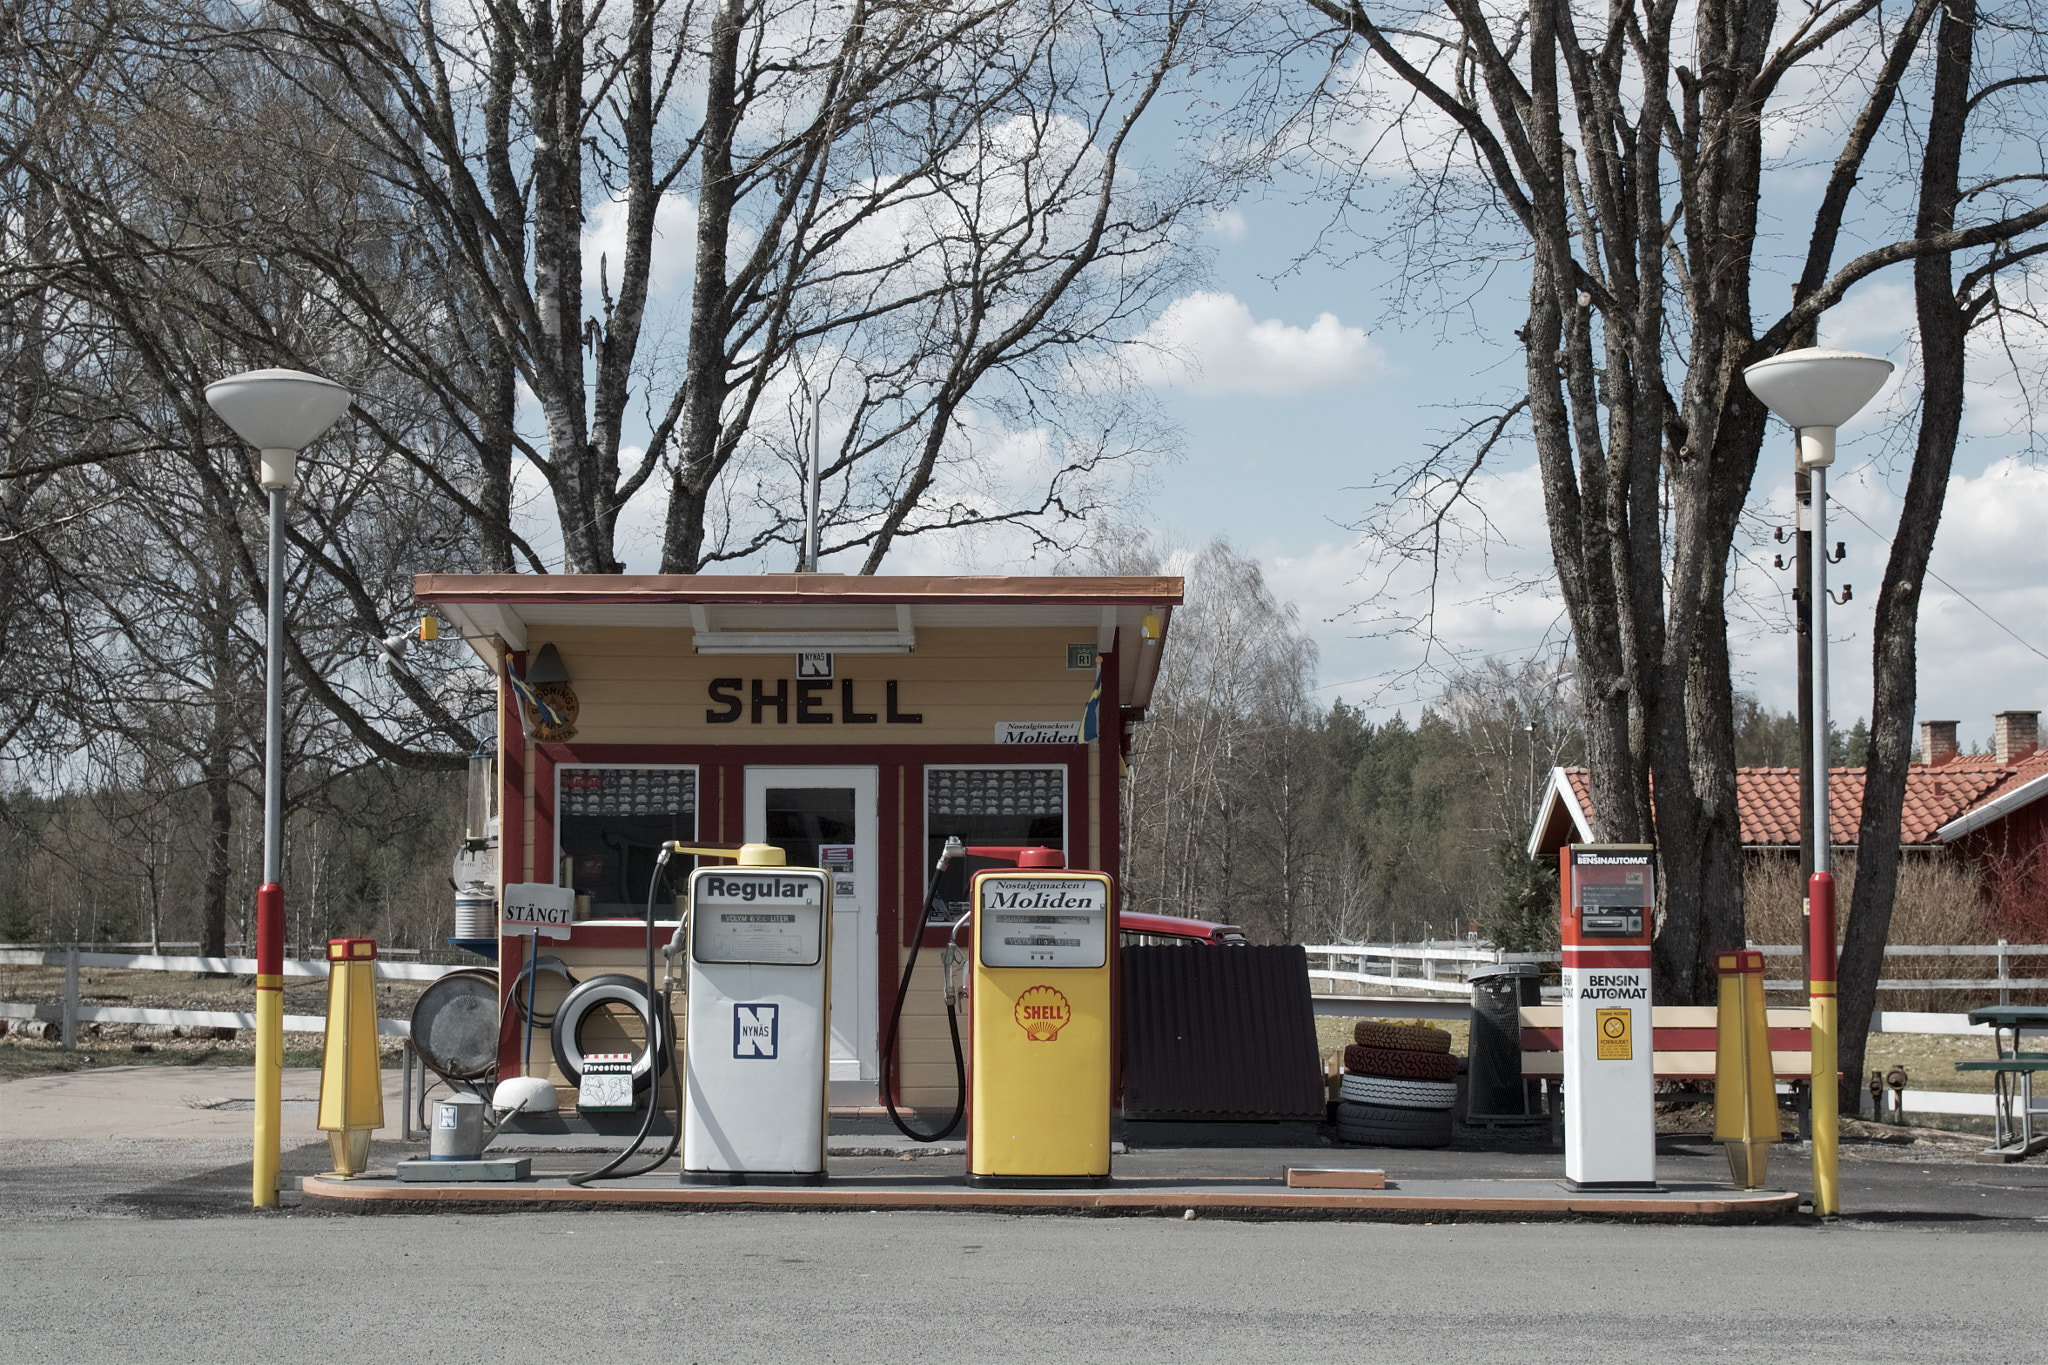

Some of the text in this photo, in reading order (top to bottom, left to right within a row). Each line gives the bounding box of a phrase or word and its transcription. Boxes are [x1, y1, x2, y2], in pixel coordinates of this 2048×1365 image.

[1079, 655, 1090, 664] R1
[706, 678, 923, 724] SHELL
[1003, 731, 1078, 744] Moliden
[1577, 857, 1648, 865] BENSINAUTOMAT
[707, 877, 809, 901] Regular
[996, 881, 1086, 891] Nostalgimacken i
[988, 892, 1093, 909] Moliden
[506, 903, 570, 924] STÄNGT
[1589, 975, 1639, 986] BENSIN
[1580, 988, 1648, 999] AUTOMAT
[1023, 1005, 1064, 1020] SHELL
[742, 1024, 769, 1037] NYNÄS
[583, 1064, 632, 1073] Firestone
